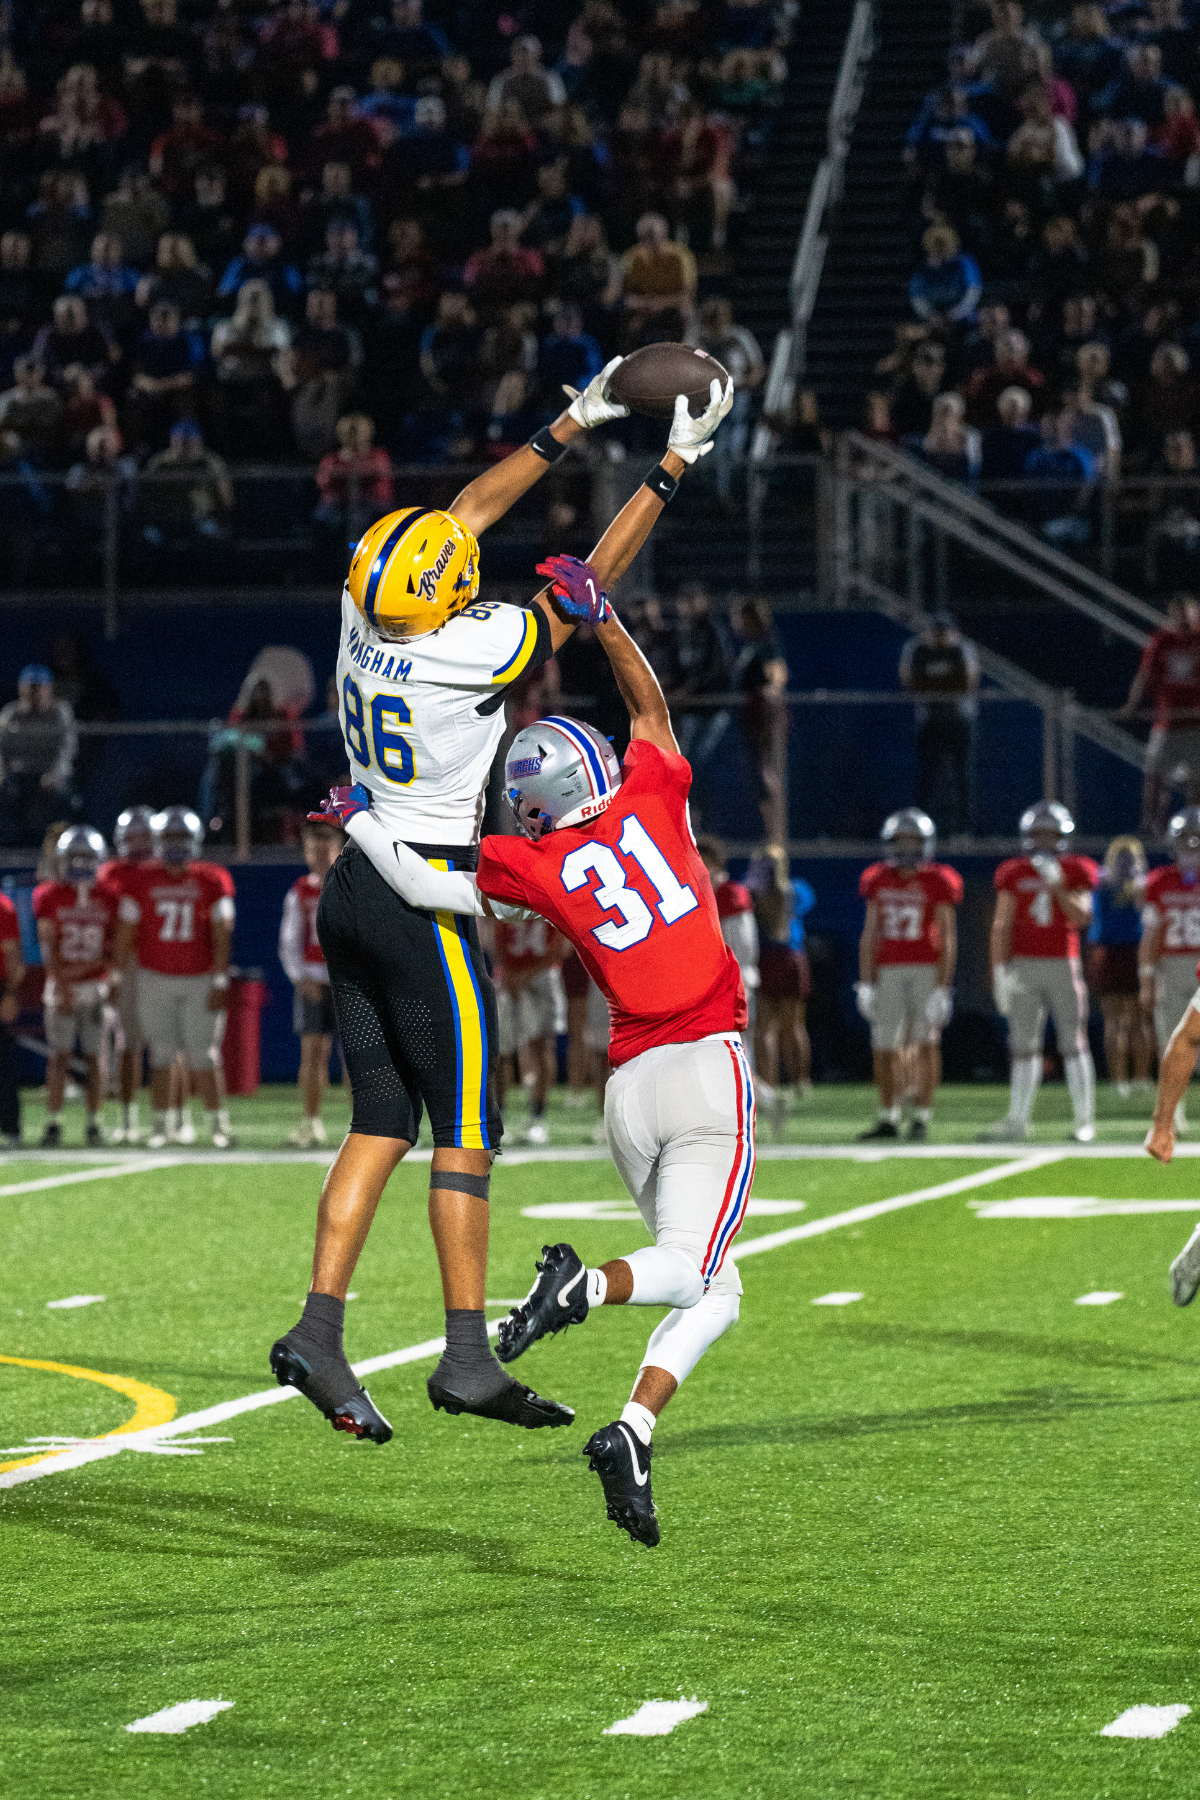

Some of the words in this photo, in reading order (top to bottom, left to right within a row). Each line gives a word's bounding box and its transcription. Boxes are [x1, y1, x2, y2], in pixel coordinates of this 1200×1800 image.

[415, 538, 457, 602] Braves
[342, 671, 417, 787] 86
[581, 795, 613, 818] Ridd
[560, 812, 700, 953] 31
[154, 901, 195, 942] 71
